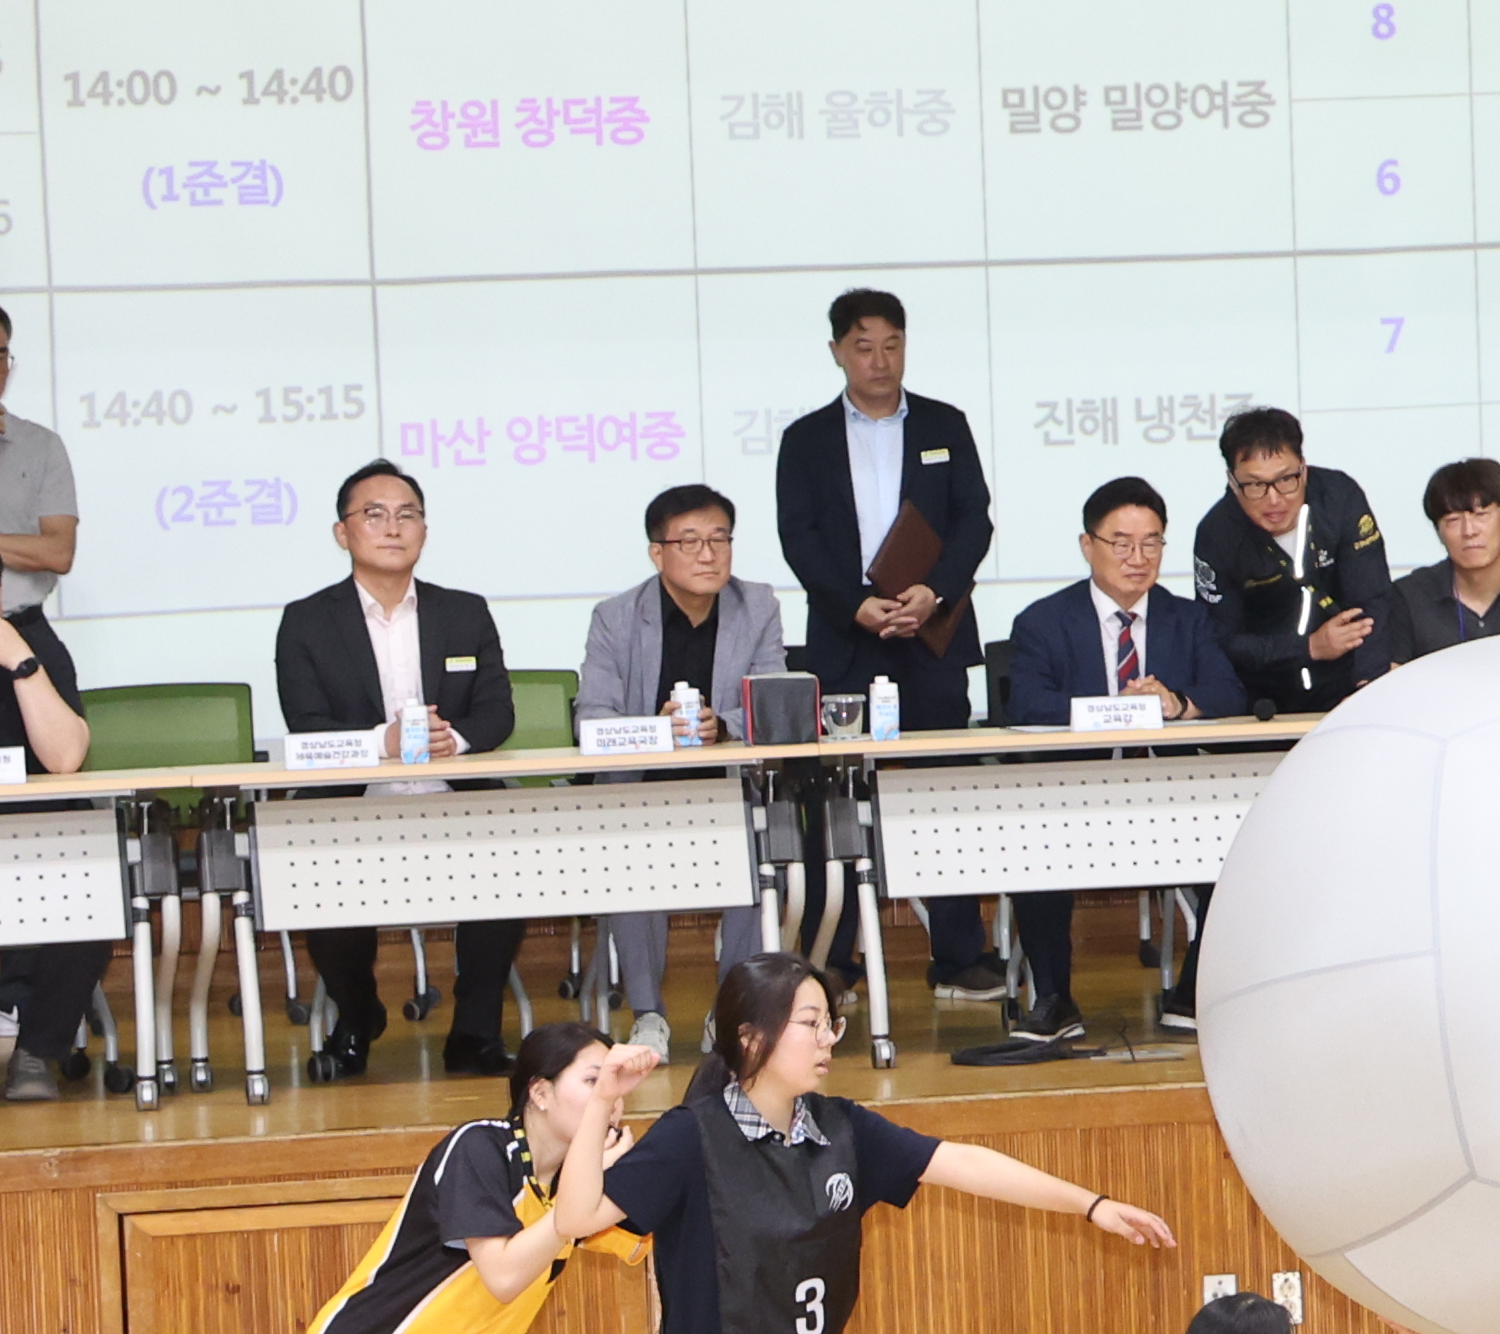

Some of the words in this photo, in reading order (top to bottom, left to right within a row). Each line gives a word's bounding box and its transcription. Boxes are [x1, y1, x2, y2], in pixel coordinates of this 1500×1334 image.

[1372, 3, 1396, 40] 8
[64, 70, 177, 107] 14:00
[239, 65, 353, 105] 14:40
[1002, 85, 1087, 134] 밀양
[1104, 80, 1276, 131] 밀양여중
[410, 99, 500, 150] 창원
[515, 97, 650, 146] 창덕중
[720, 91, 804, 140] 김해
[142, 159, 283, 210] (1준결)
[1377, 159, 1401, 196] 6
[1381, 317, 1405, 353] 7
[80, 389, 193, 429] 14:40
[256, 384, 365, 423] 15:15
[1034, 397, 1119, 446] 진해
[401, 419, 491, 466] 마산
[507, 411, 686, 463] 양덕여중
[156, 477, 298, 530] (2준결)
[301, 739, 362, 750] 경상남도교육청
[596, 725, 657, 736] 경상남도교육청
